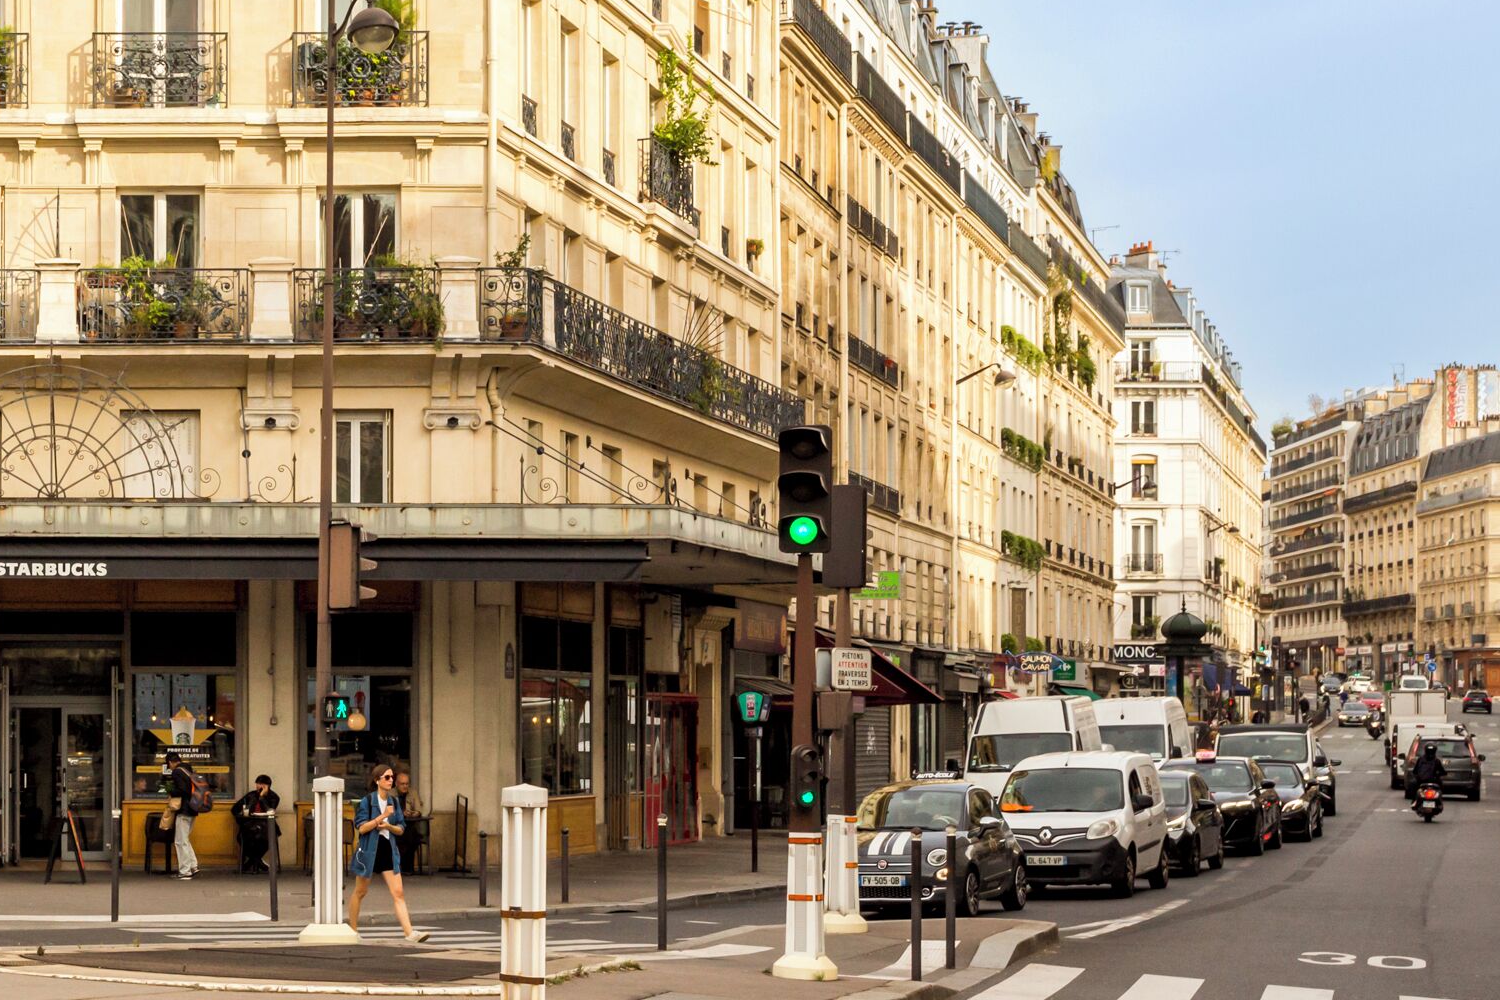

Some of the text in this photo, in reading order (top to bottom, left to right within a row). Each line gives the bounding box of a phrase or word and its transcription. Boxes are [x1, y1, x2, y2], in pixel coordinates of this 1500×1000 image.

[1113, 645, 1157, 659] MONC
[1020, 662, 1050, 671] CAVIAR
[1297, 951, 1427, 970] 30
